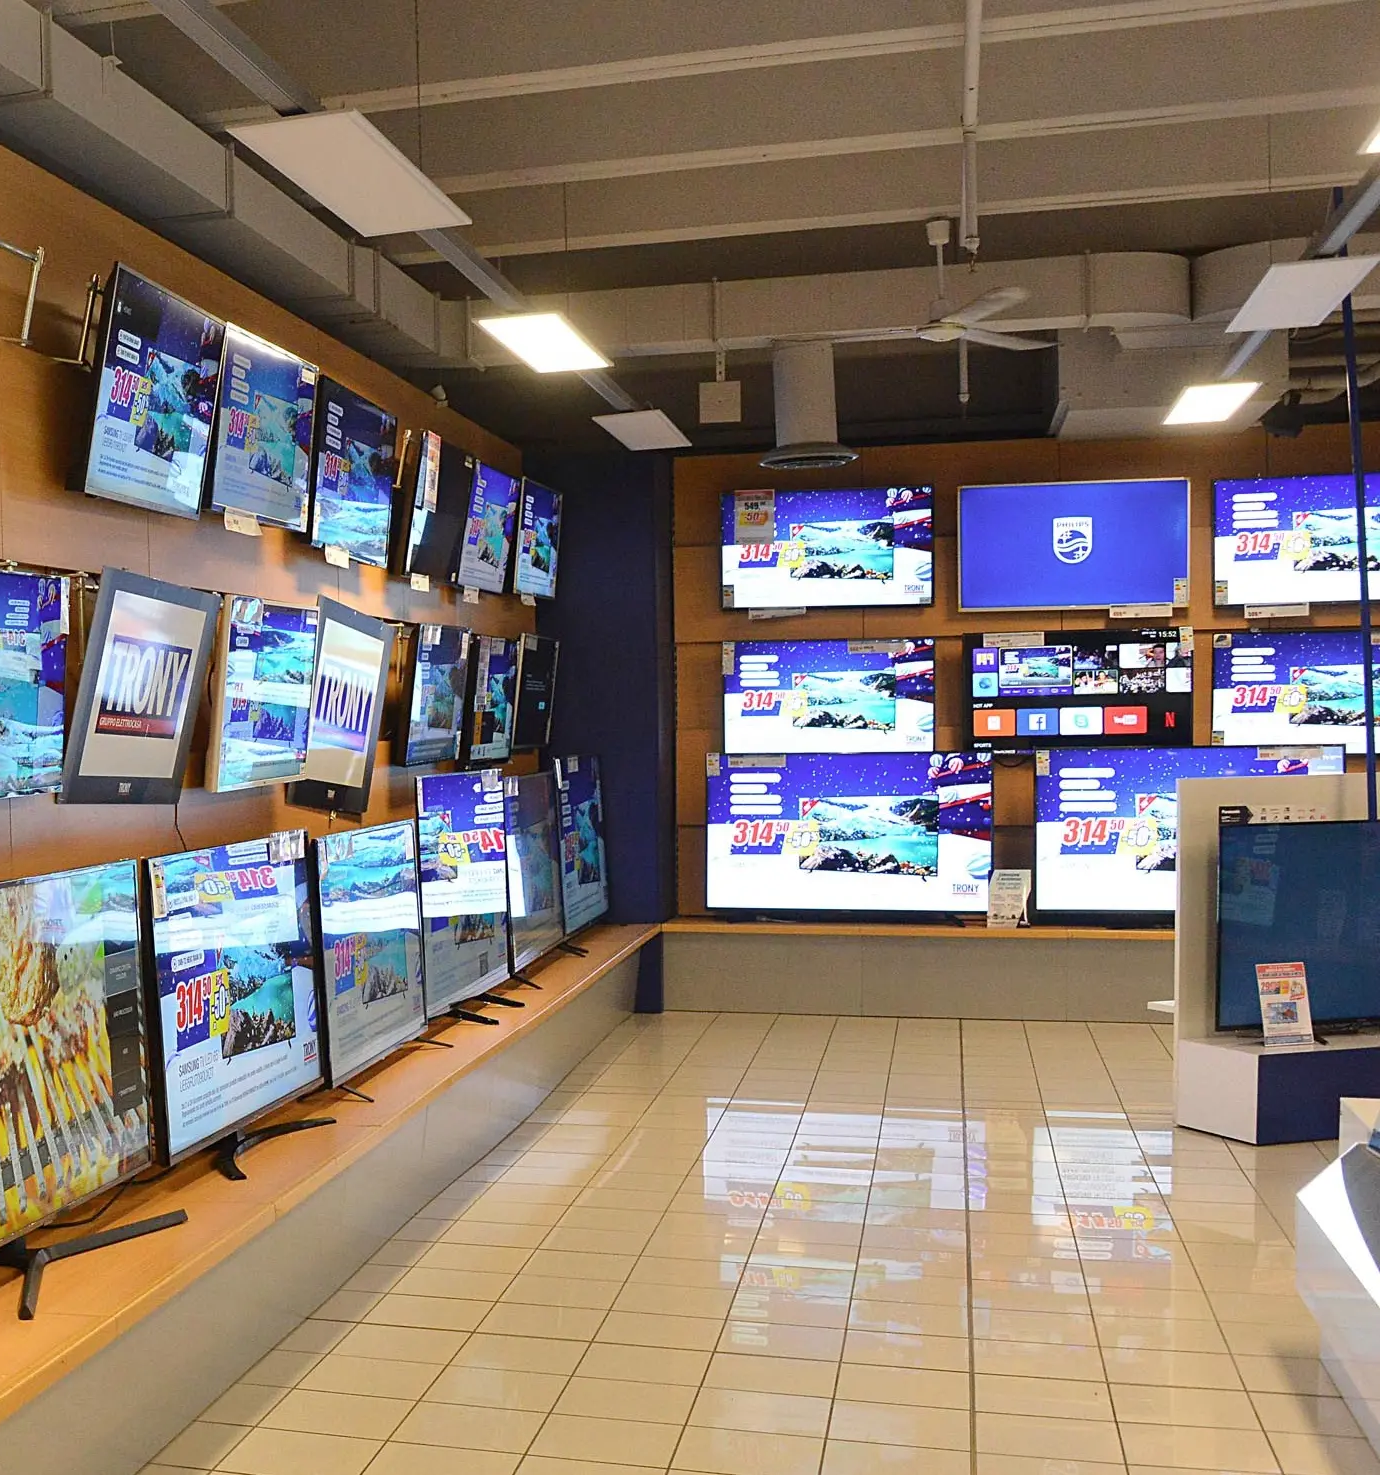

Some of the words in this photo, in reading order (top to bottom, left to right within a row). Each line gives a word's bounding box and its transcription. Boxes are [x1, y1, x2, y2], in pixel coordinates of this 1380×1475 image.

[110, 368, 133, 407] 314
[740, 543, 771, 561] 314
[1236, 534, 1271, 555] 314
[903, 584, 925, 593] TRONY
[1158, 630, 1177, 638] 15:52
[106, 641, 189, 717] TRONY
[319, 664, 374, 733] TRONY
[743, 691, 773, 709] 314
[1234, 686, 1267, 707] 314
[733, 821, 773, 846] 314
[1063, 820, 1108, 847] 314
[952, 884, 979, 893] TRONY
[176, 979, 203, 1029] 314
[303, 1039, 317, 1056] TRONY
